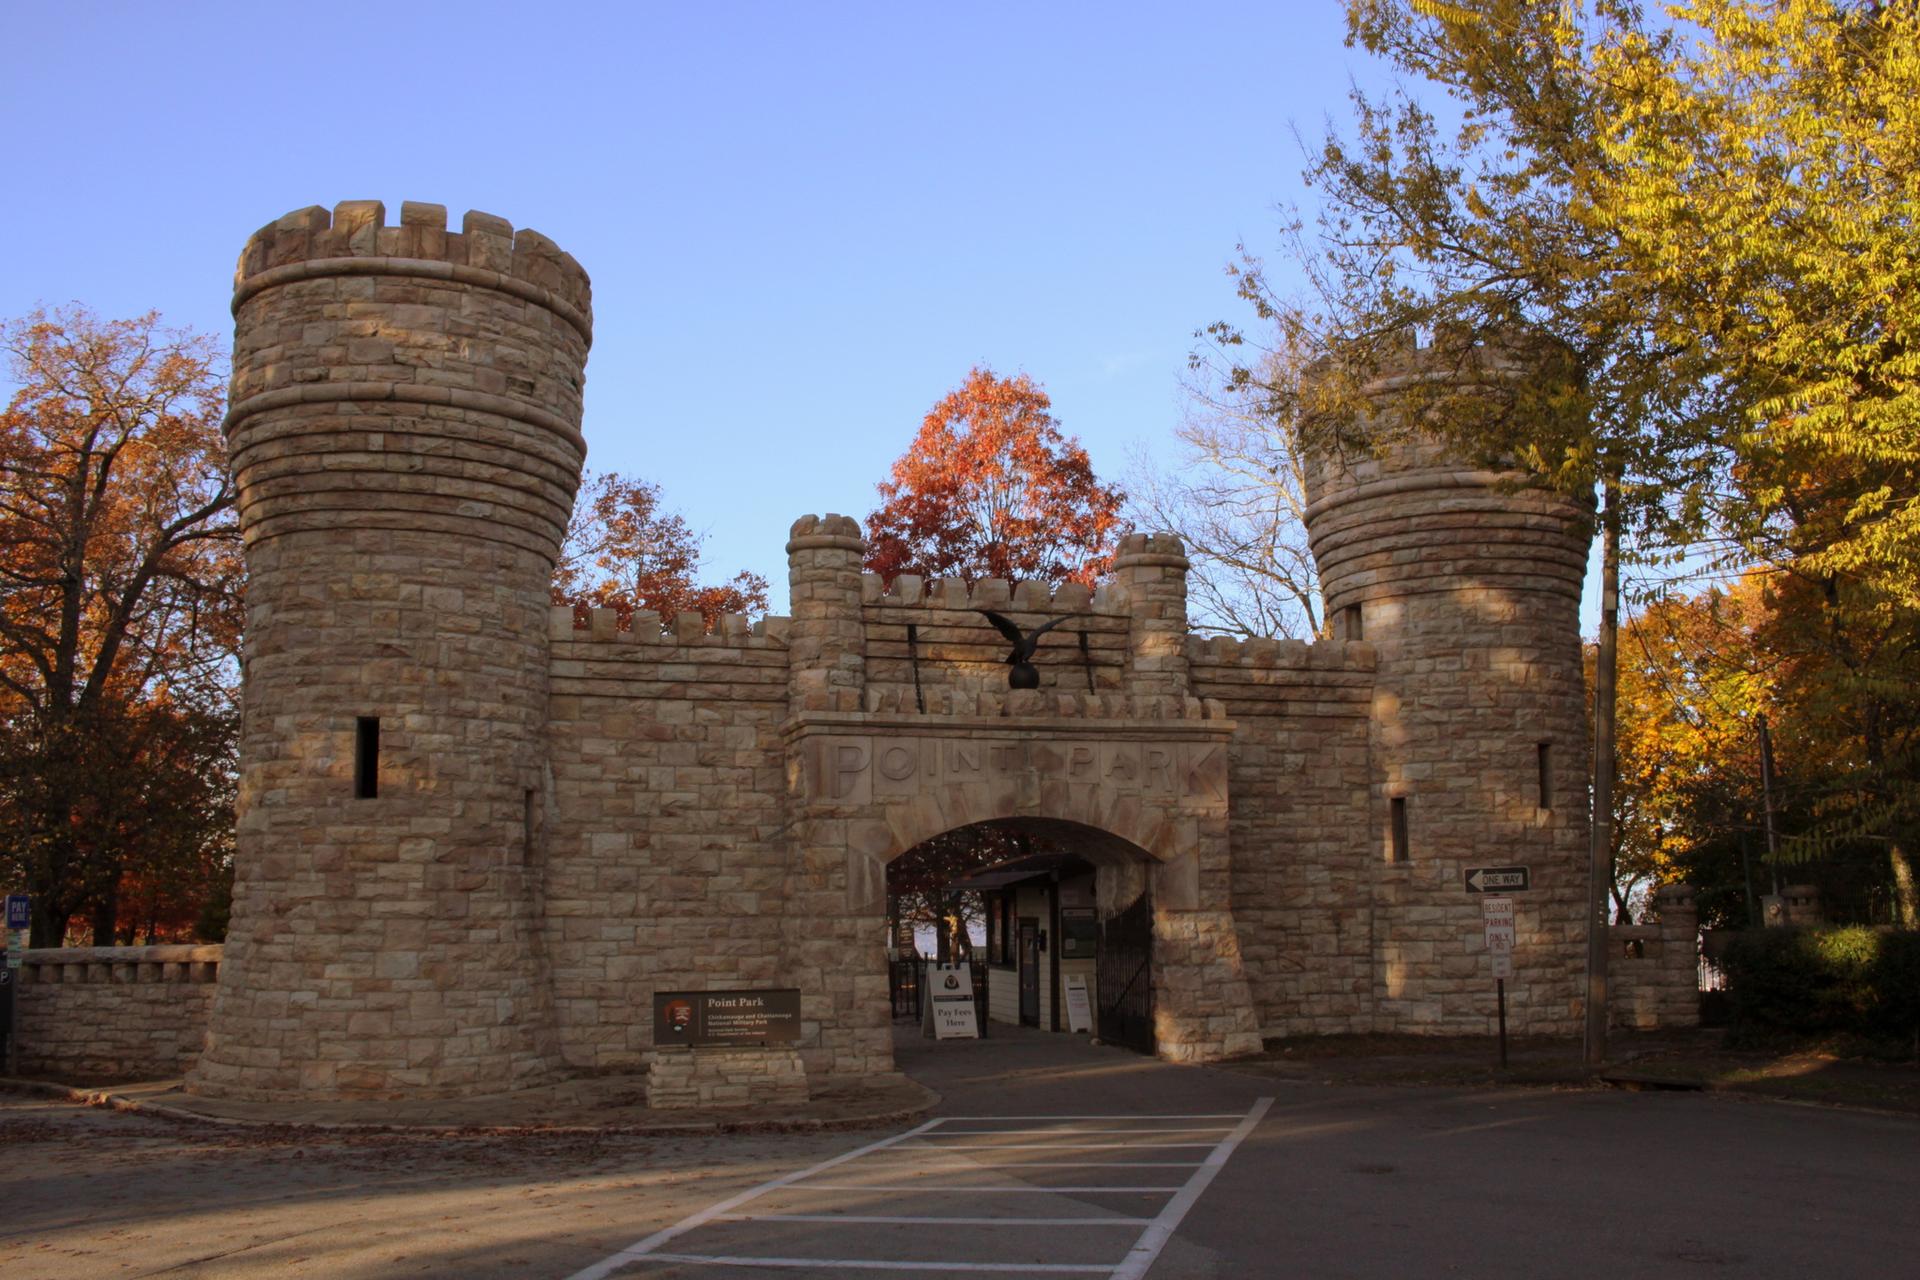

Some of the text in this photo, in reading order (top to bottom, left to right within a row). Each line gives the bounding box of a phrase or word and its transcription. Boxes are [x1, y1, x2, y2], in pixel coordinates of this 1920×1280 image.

[831, 746, 1226, 803] POINT PARK
[1483, 874, 1520, 885] ONE WAY
[12, 901, 27, 912] PAY
[1485, 903, 1512, 913] RESIDENT
[1485, 918, 1513, 927] PARKING
[1490, 933, 1509, 942] ONLY
[708, 997, 764, 1008] Point Park
[938, 1009, 952, 1017] Pay
